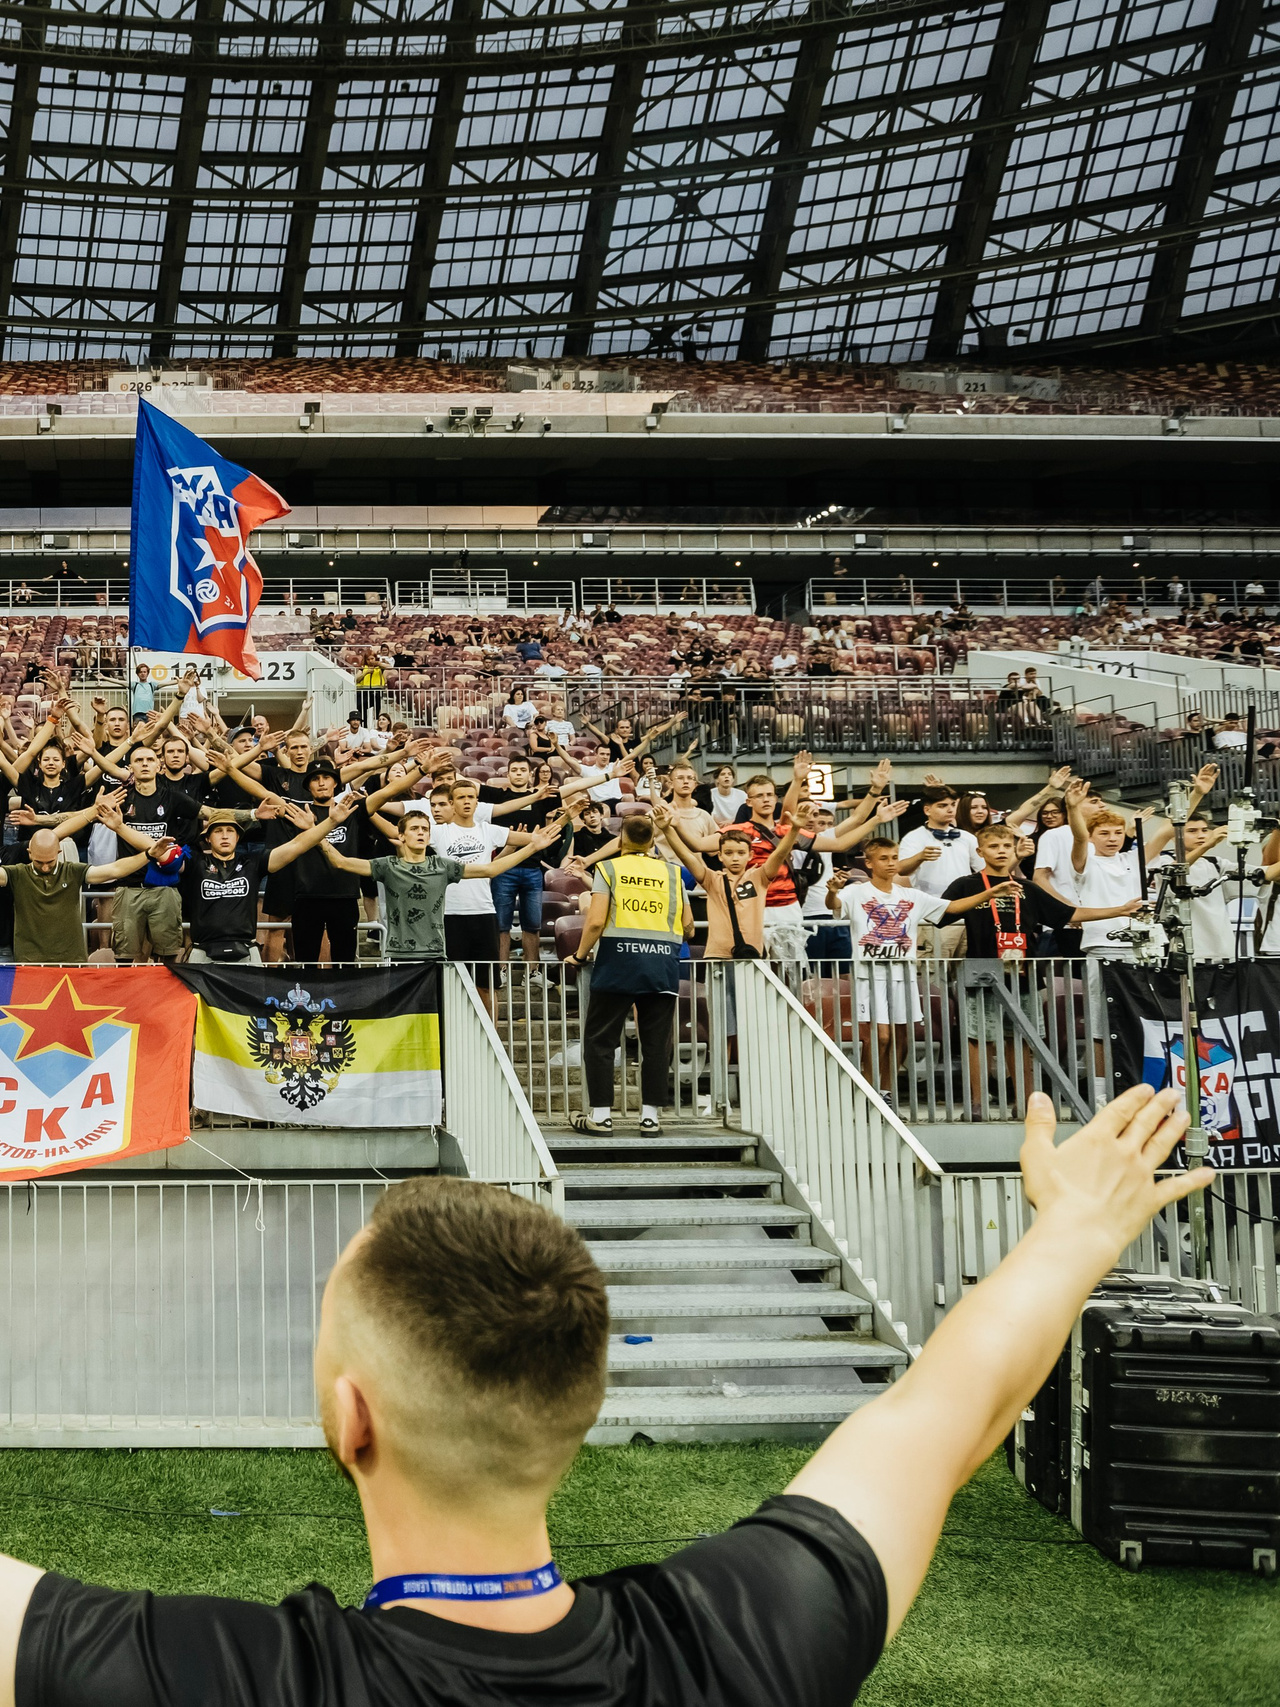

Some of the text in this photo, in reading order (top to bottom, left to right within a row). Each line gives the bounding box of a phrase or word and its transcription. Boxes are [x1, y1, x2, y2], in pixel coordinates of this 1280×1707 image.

[130, 382, 152, 392] 226
[171, 662, 213, 680] 14
[621, 876, 664, 888] SAFETY
[623, 899, 663, 914] K0459
[617, 943, 671, 954] STEWARD
[863, 943, 910, 958] REALITY
[403, 1580, 430, 1594] LEAGUE
[431, 1579, 473, 1596] FOOTBALL
[474, 1580, 502, 1595] MEDIA
